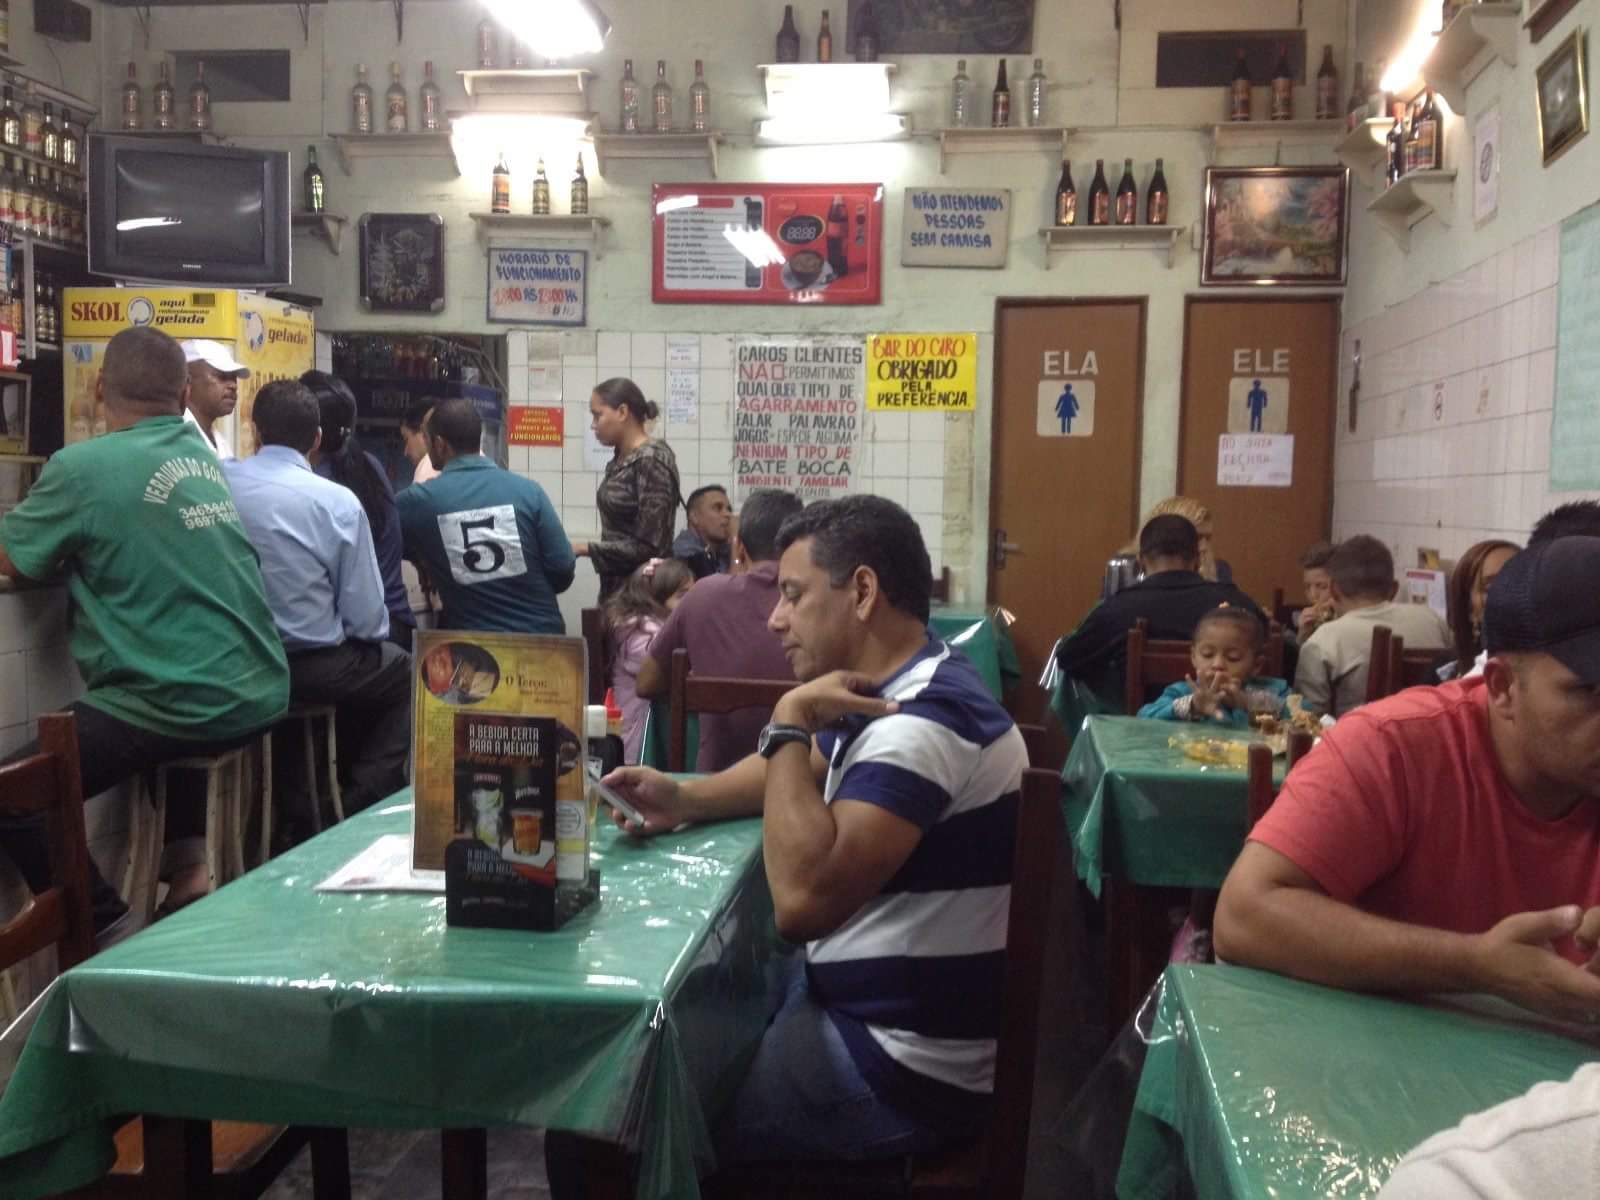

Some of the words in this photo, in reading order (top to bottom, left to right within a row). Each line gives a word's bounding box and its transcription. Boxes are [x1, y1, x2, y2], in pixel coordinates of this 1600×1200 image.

[924, 213, 985, 229] PESSOAS
[911, 232, 936, 247] SEM
[941, 233, 992, 248] CAMISA
[555, 254, 570, 265] DE
[160, 298, 185, 308] aqui
[71, 302, 125, 321] SKOL
[155, 313, 205, 325] gelada
[268, 327, 308, 345] gelada
[739, 345, 788, 362] CAROS
[795, 346, 863, 364] CLIENTES
[873, 337, 901, 359] BAR
[906, 338, 926, 357] DO
[1043, 350, 1098, 376] ELA
[1233, 349, 1290, 373] ELE
[877, 359, 957, 380] OBRIGADO
[737, 382, 797, 397] QUALQUER
[801, 383, 830, 398] TIPO
[840, 383, 854, 398] DE
[901, 381, 932, 392] PELA
[738, 398, 857, 413] AGARRAMENTO
[736, 412, 772, 427] FALAR
[735, 428, 769, 443] JOGOS
[736, 444, 788, 458] NENHUM
[794, 445, 828, 459] TIPO
[836, 446, 852, 460] DE
[738, 460, 787, 474] BATE
[798, 460, 851, 475] BOCA
[460, 515, 505, 573] 5
[469, 723, 475, 737] A
[478, 724, 509, 740] BEBIDA
[511, 726, 539, 741] CERTA
[469, 738, 492, 753] PARA
[495, 741, 501, 755] A
[503, 741, 539, 758] MELHOR
